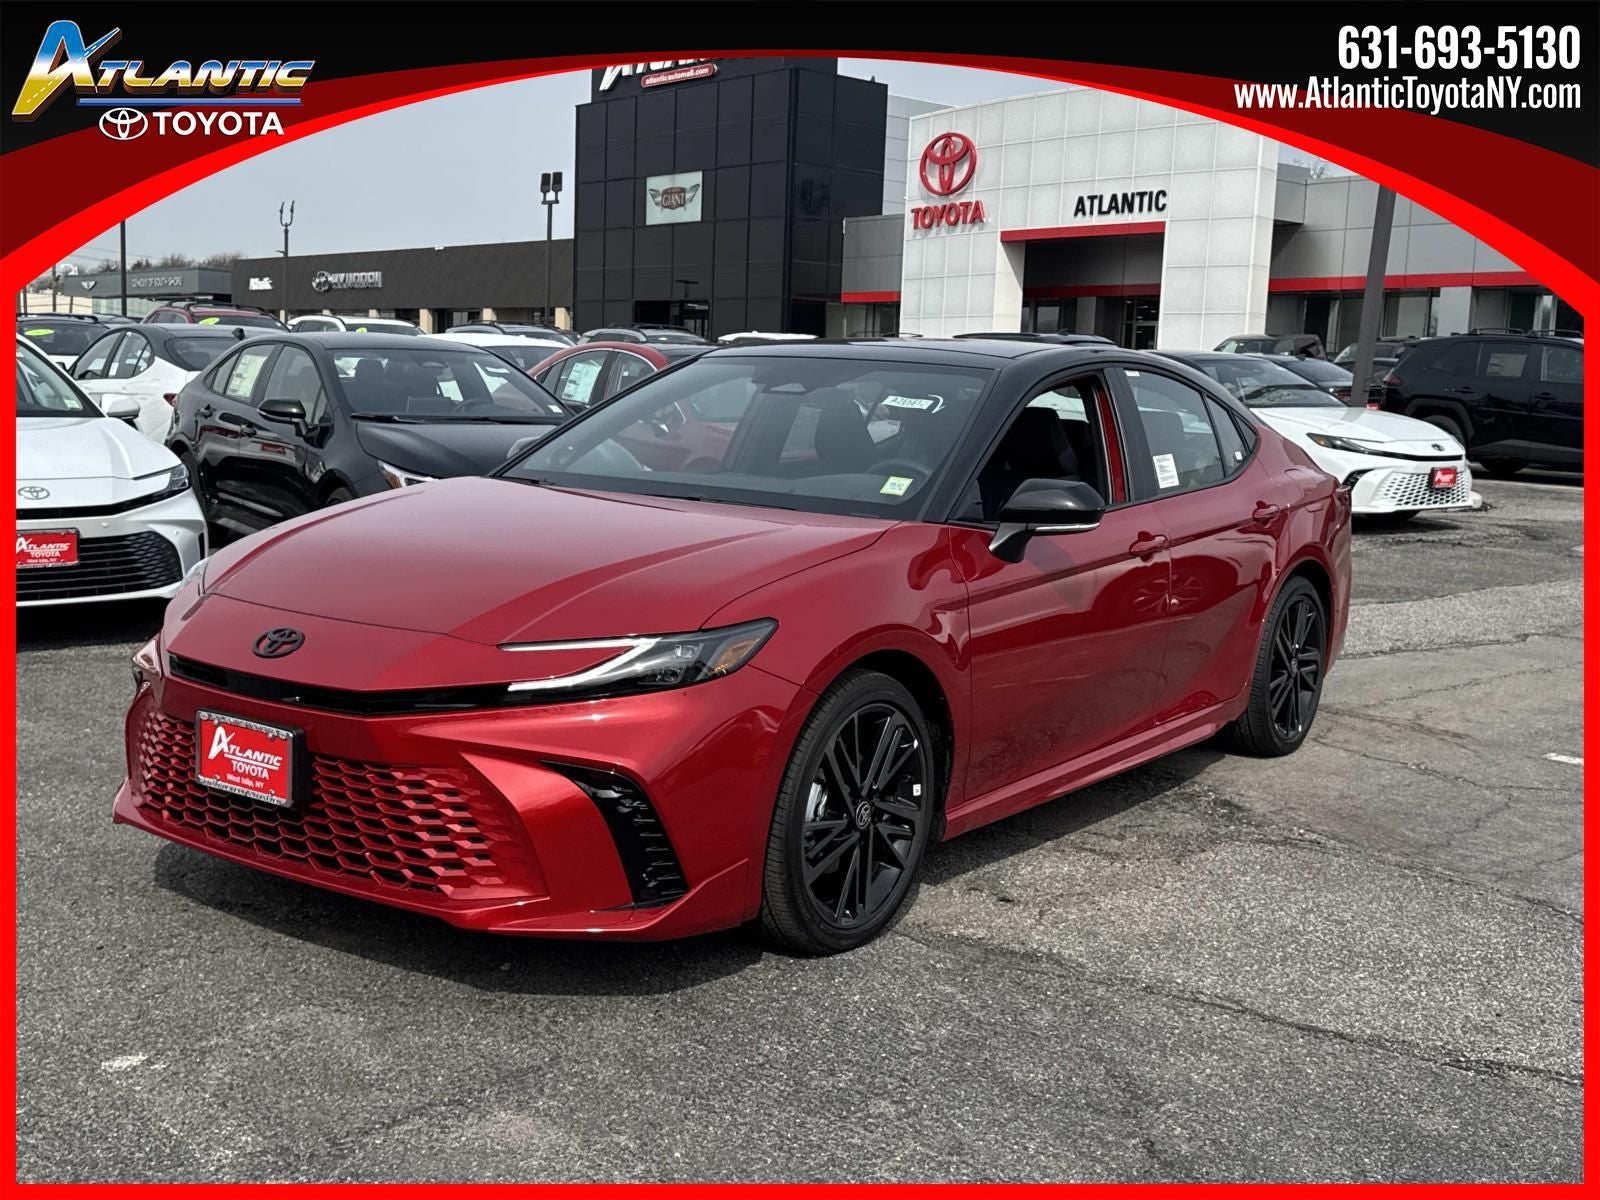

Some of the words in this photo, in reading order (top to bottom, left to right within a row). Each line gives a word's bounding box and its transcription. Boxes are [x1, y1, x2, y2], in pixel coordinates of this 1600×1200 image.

[911, 200, 985, 230] TOYOTA
[1073, 189, 1167, 217] ATLANTIC
[208, 726, 283, 767] ATLANTIC
[226, 773, 240, 782] West
[255, 780, 265, 789] NY
[231, 760, 269, 780] TOYOTA
